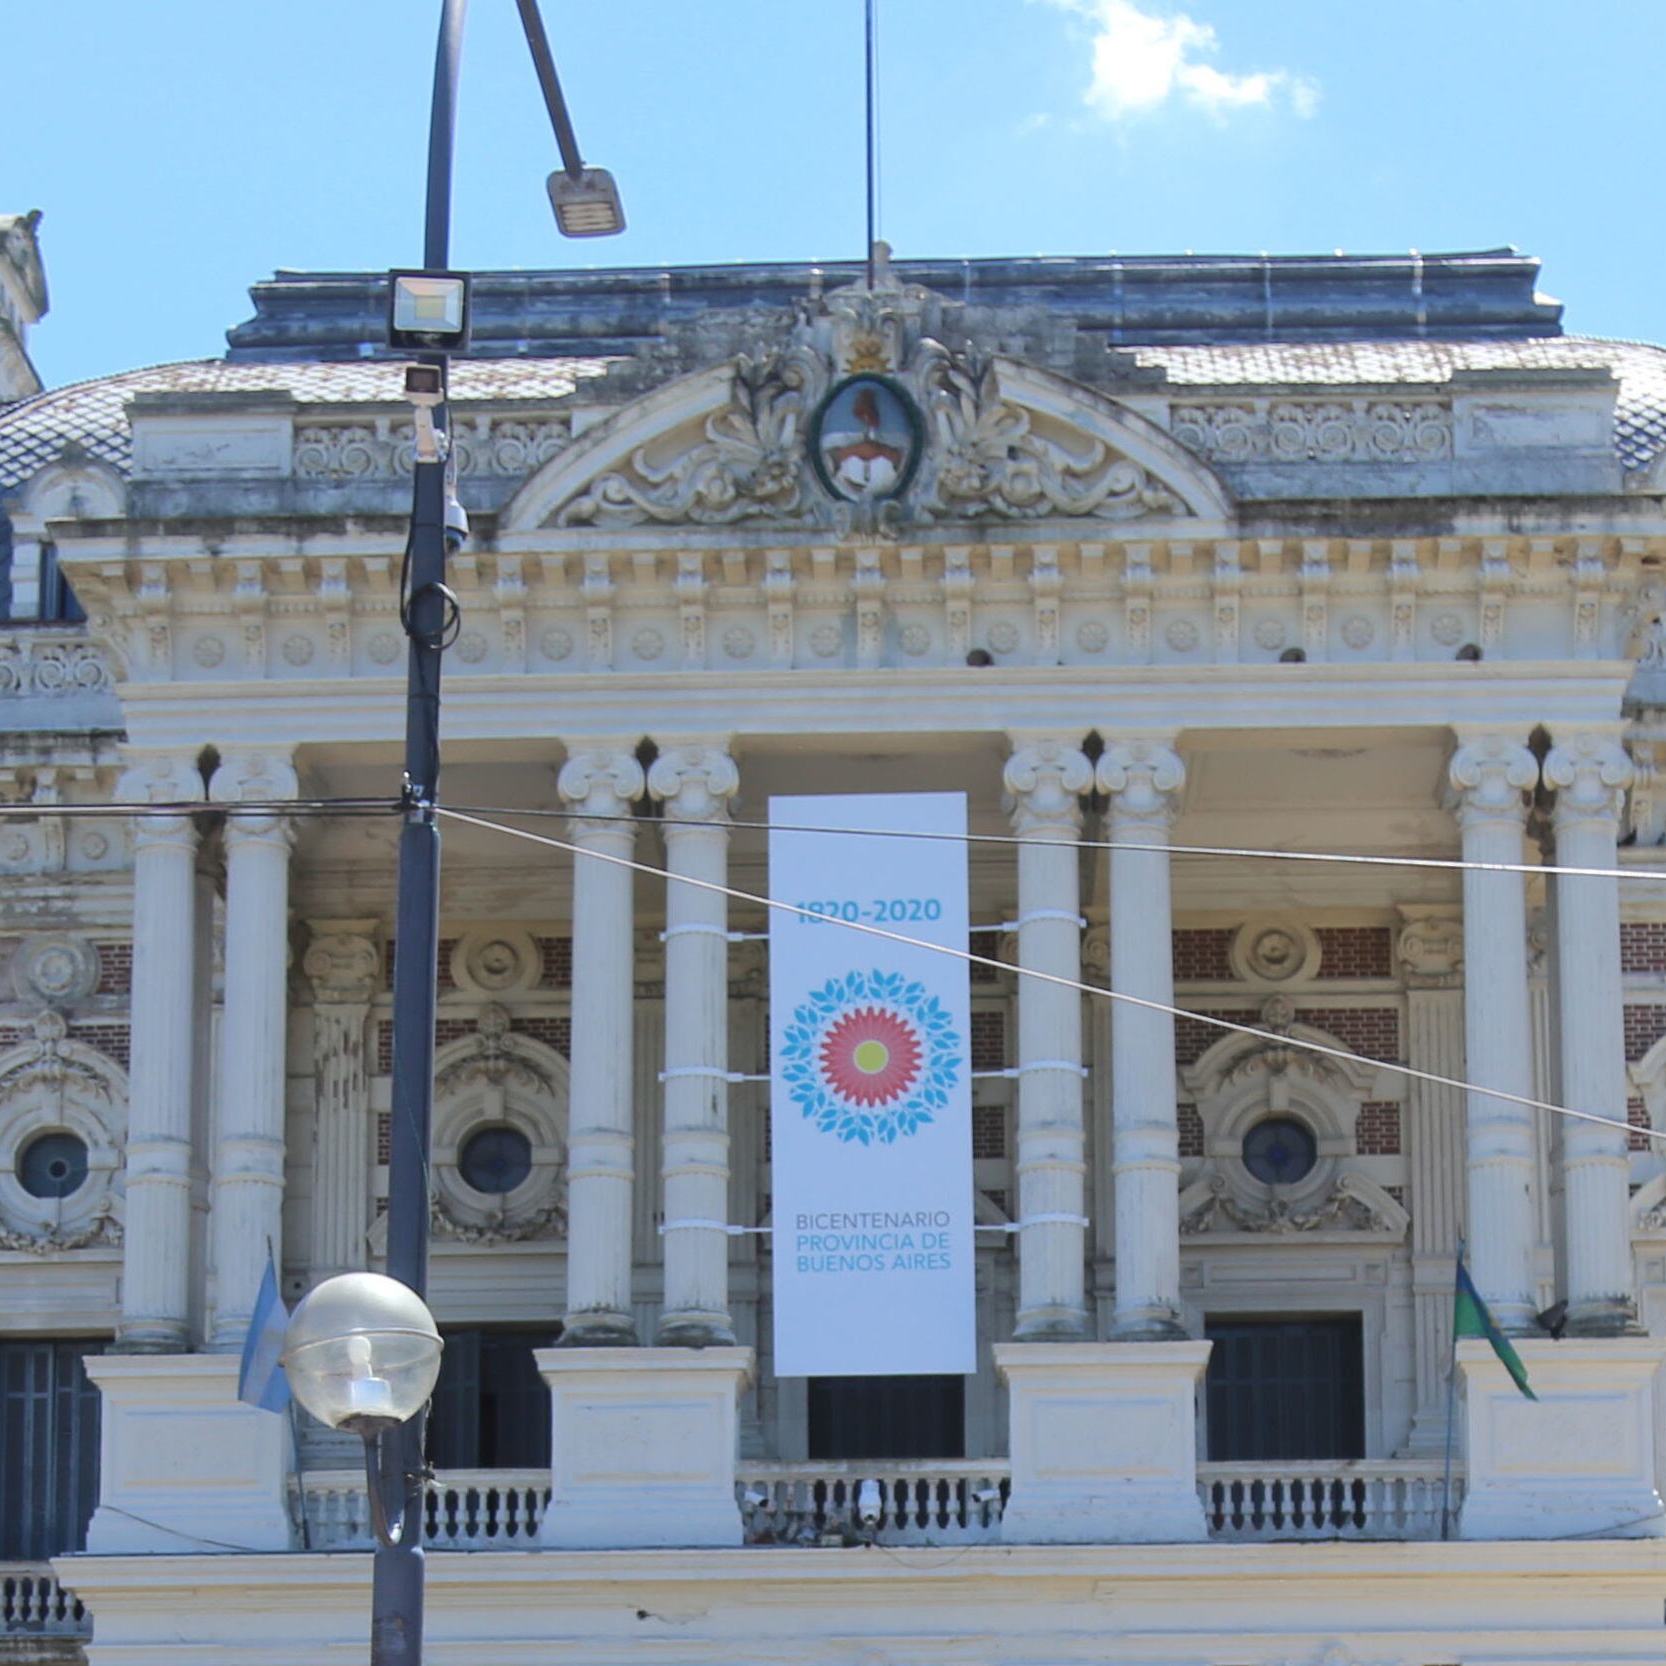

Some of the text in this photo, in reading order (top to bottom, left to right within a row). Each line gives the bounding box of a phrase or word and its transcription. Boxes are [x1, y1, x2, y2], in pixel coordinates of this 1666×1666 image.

[797, 899, 942, 923] 1820-2020
[796, 1211, 950, 1230] BICENTENARIO
[797, 1232, 950, 1251] PROVINCIA DE
[797, 1252, 951, 1272] BUENOS AIRES
